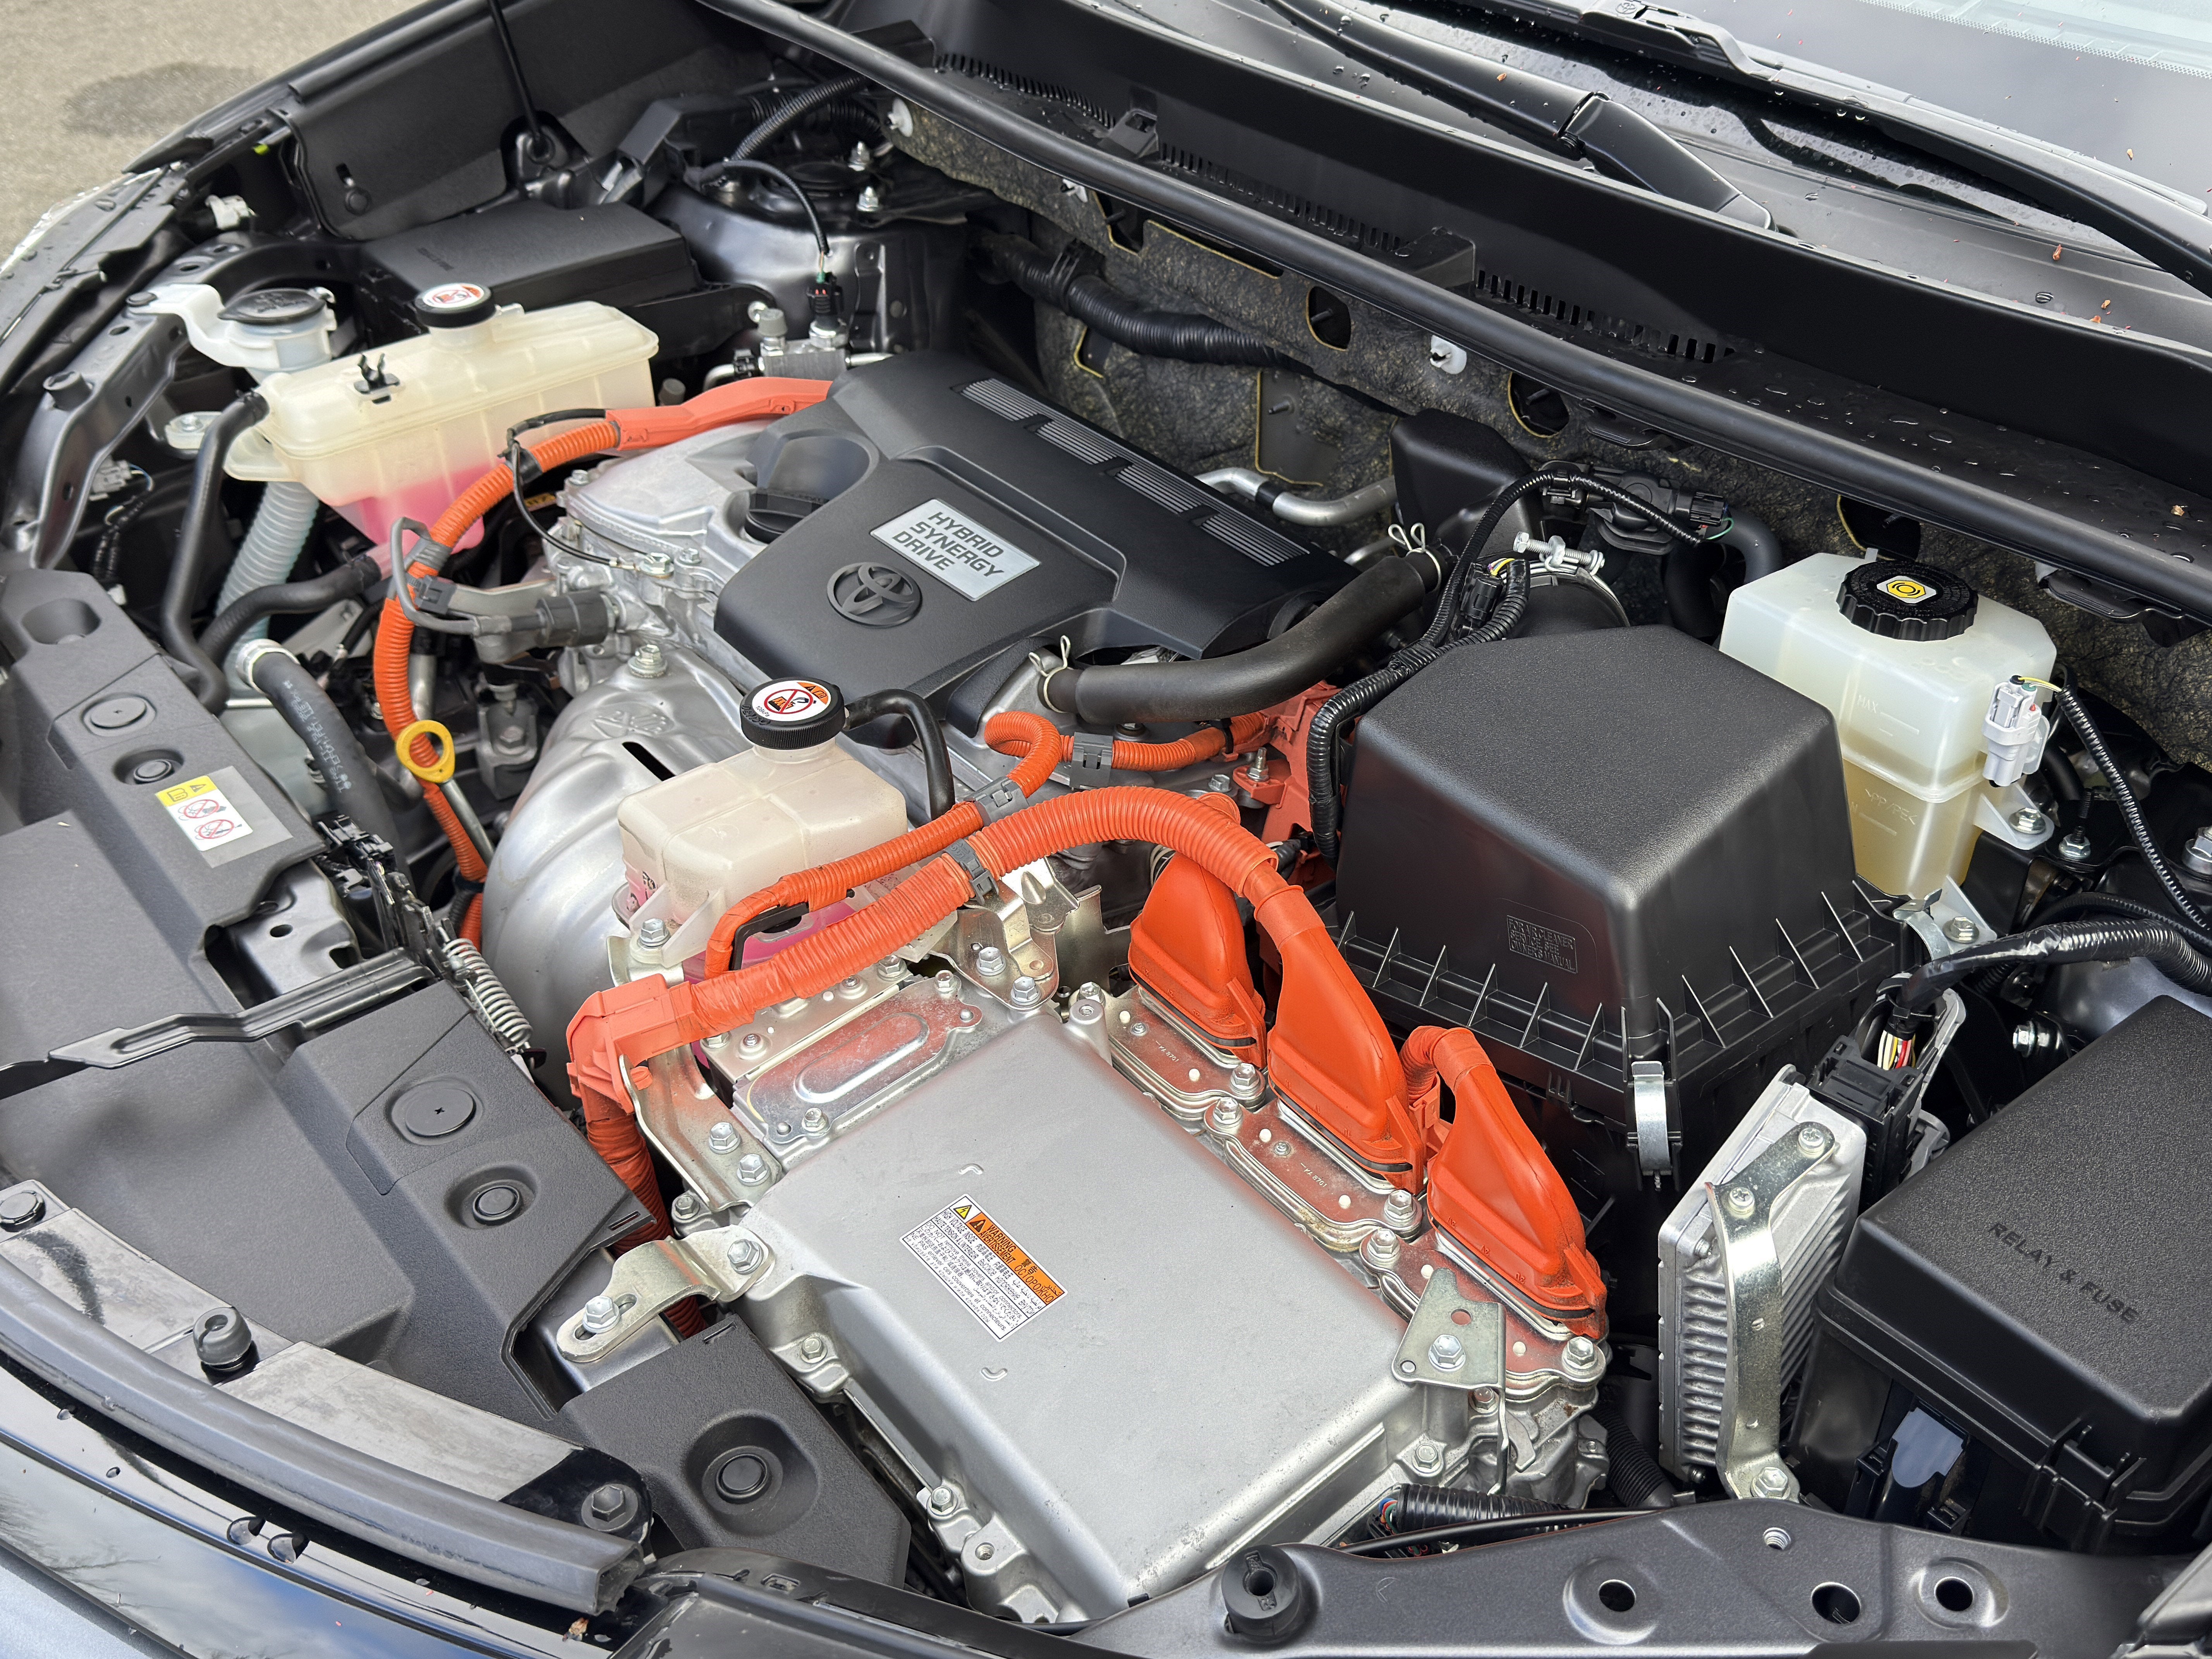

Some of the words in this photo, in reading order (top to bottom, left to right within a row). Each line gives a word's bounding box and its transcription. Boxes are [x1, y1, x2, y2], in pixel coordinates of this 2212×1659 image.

[891, 531, 955, 571] DRIVE
[909, 521, 1005, 577] SYNERGY
[927, 512, 1004, 558] HYBRID
[1857, 695, 1878, 713] MAX
[1509, 919, 1524, 933] FOR
[1539, 929, 1573, 950] CLEANER
[1511, 929, 1541, 950] SERVICE
[1544, 941, 1559, 955] SEE
[1312, 1175, 1328, 1187] 8701
[933, 1216, 947, 1228] HAUTE
[943, 1224, 959, 1240] TENSION
[940, 1209, 953, 1220] HIGH
[949, 1217, 967, 1234] VOLTAGE
[962, 1231, 977, 1244] INSIDE
[987, 1224, 1016, 1253] WARNING
[978, 1230, 1015, 1264] AVERTISSEMENT
[910, 1232, 919, 1240] NE
[917, 1240, 929, 1250] PAS
[927, 1251, 944, 1266] enlever
[943, 1266, 952, 1275] ces
[951, 1275, 974, 1298] couvercles
[980, 1304, 1006, 1331] connecteurs.
[926, 1221, 935, 1230] DO
[933, 1229, 945, 1239] NOT
[944, 1240, 959, 1255] remove
[959, 1255, 971, 1267] these
[971, 1267, 985, 1281] covers
[984, 1281, 1000, 1295] and/or
[999, 1295, 1022, 1319] connectors.
[1014, 1264, 1054, 1302] ОСТОРОЖНО
[1021, 1258, 1038, 1274] 警告
[1989, 1223, 2060, 1268] RELAY
[2059, 1269, 2076, 1284] &
[2080, 1281, 2142, 1322] FUSE
